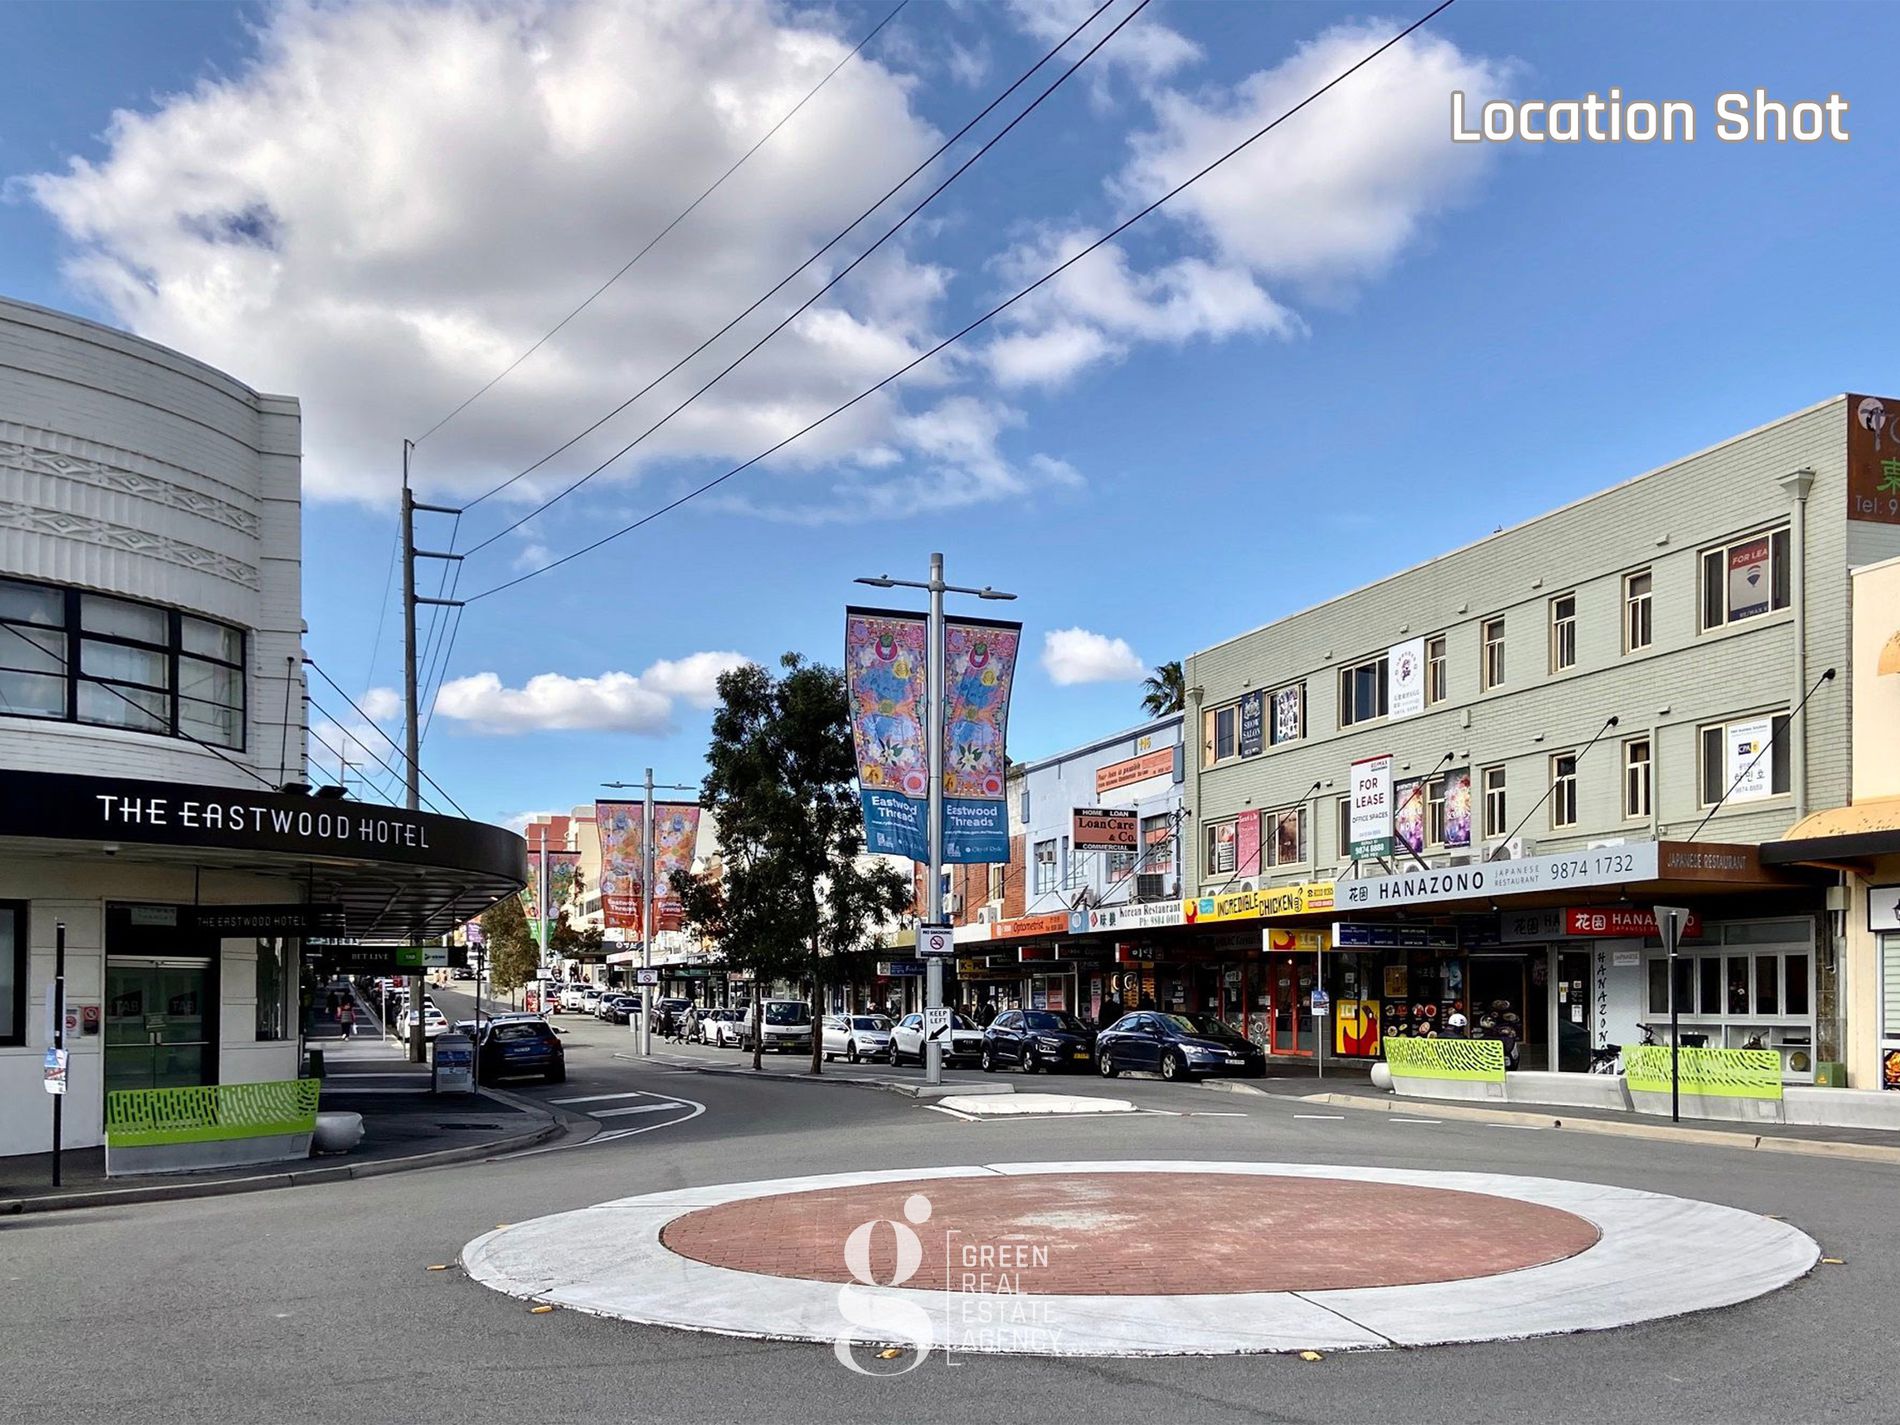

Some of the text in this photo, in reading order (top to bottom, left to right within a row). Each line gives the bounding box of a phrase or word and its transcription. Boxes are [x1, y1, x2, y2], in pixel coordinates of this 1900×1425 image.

[1855, 495, 1883, 515] Tel:
[1731, 553, 1750, 566] FOR
[1243, 719, 1259, 730] SHOW
[1243, 728, 1261, 738] SALON
[1359, 777, 1378, 792] FOR
[1356, 792, 1385, 809] LEASE
[946, 804, 998, 817] Eastwood
[1082, 809, 1129, 818] HOME LOAN
[96, 795, 430, 849] THE EASTWOOD HOTEL
[950, 815, 994, 828] Threads
[1352, 811, 1388, 824] OFFICE SPACES
[1109, 832, 1136, 842] & Co.
[1082, 843, 1129, 851] COMMERCIAL
[1550, 854, 1633, 880] 9874 1732
[1667, 854, 1747, 870] JAPANESE RESTAURANT
[1494, 865, 1540, 878] JAPANESE
[1379, 871, 1485, 900] HANAZONO
[1494, 875, 1540, 888] RESTAURANT
[1119, 902, 1181, 918] Korean Restaurant
[1217, 892, 1259, 917] INCREDIBLE
[1258, 892, 1295, 917] CHICKEN
[197, 916, 307, 927] THE EASTWOOD HOTEL
[1612, 913, 1695, 927] HANAO
[1013, 920, 1044, 934] Optometrist
[116, 999, 139, 1012] TAB
[173, 999, 195, 1012] TAB
